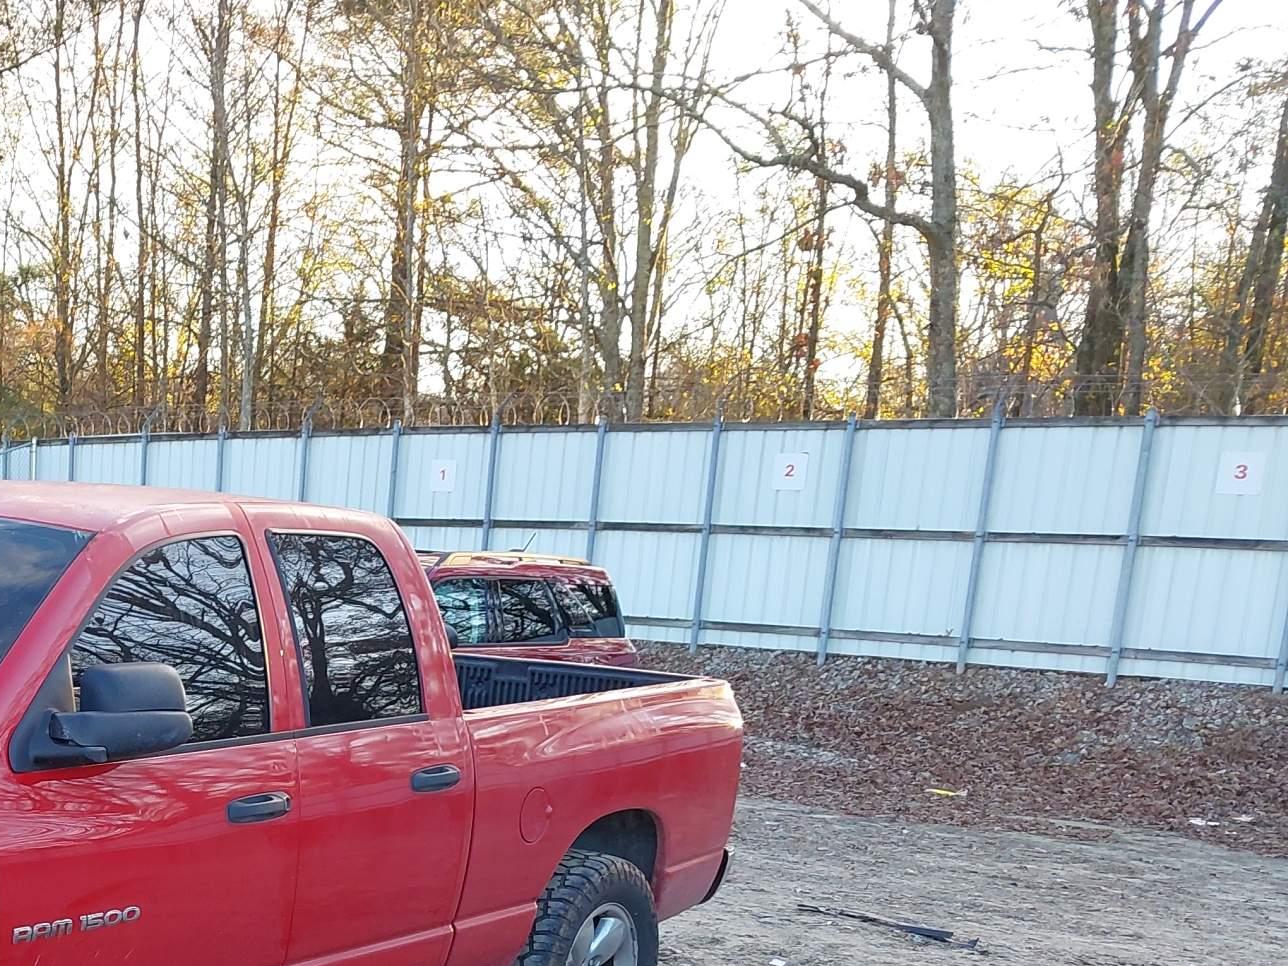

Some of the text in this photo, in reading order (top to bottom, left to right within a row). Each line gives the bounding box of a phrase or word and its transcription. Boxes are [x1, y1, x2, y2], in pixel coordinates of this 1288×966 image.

[439, 469, 446, 481] 1
[784, 464, 795, 477] 2
[1234, 464, 1249, 480] 3
[12, 906, 141, 944] RAM 1500
